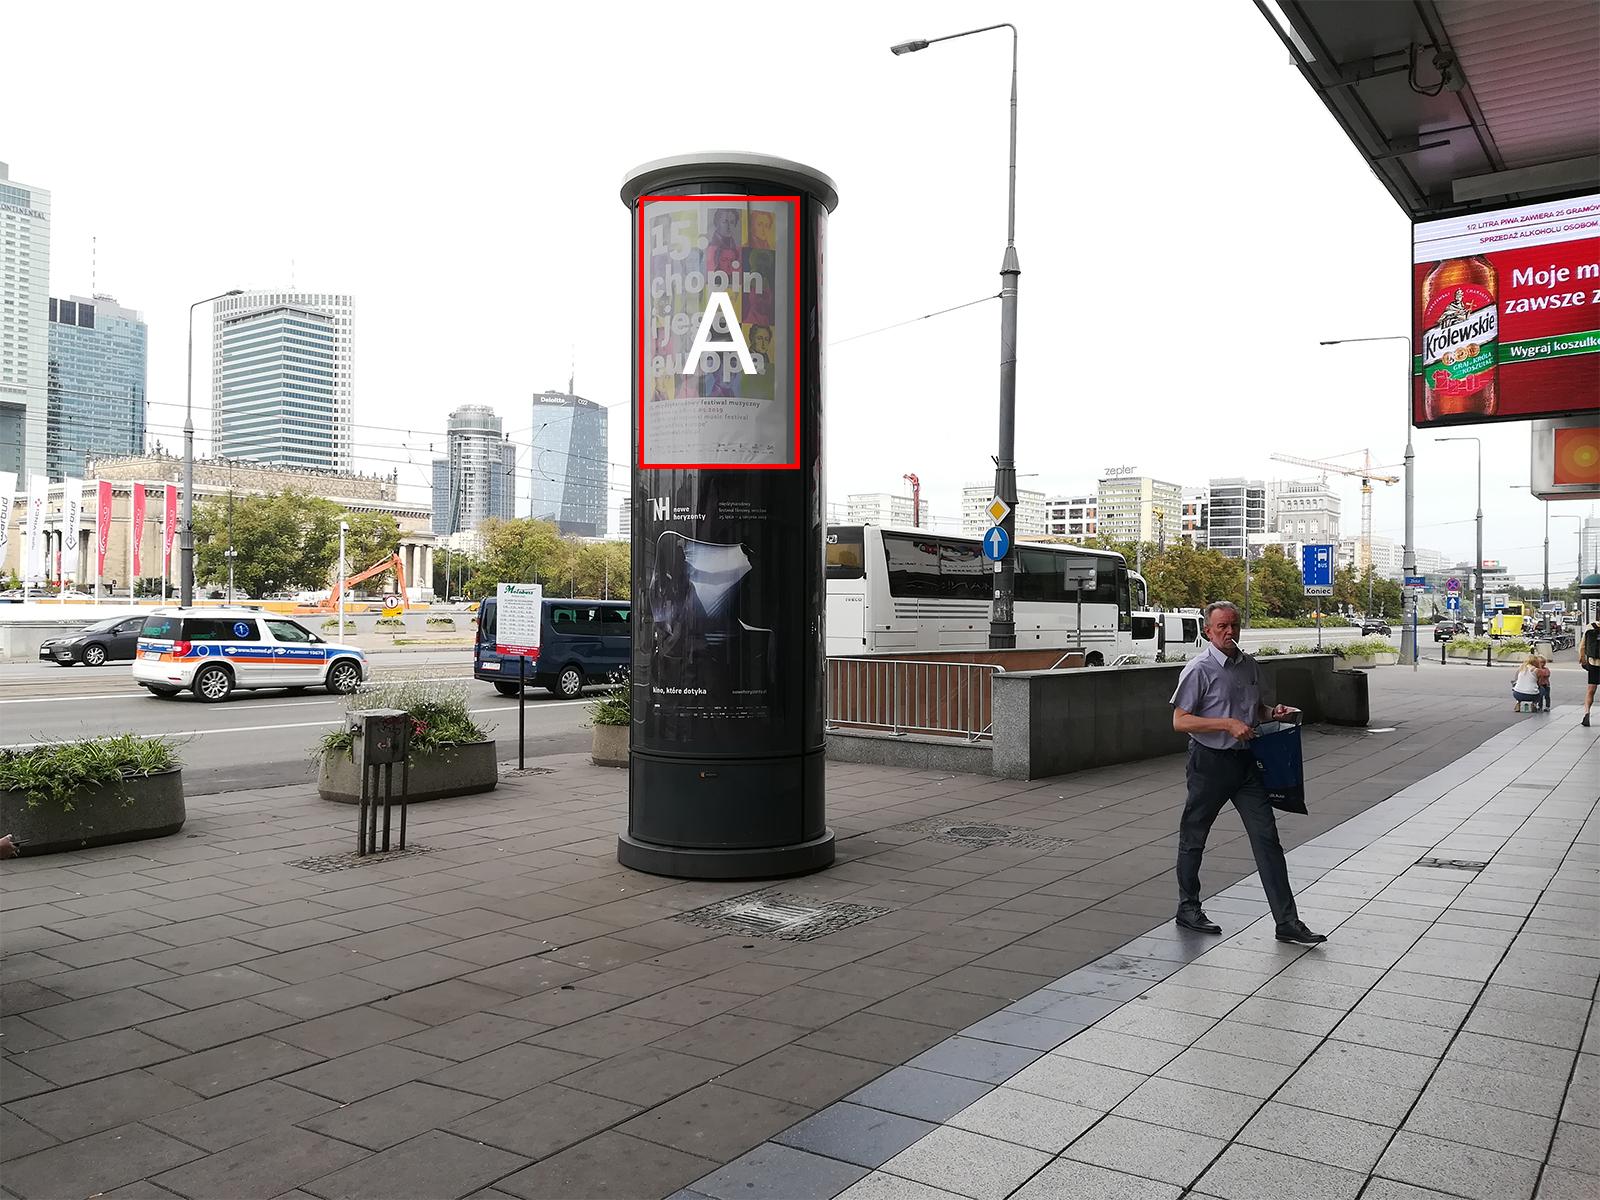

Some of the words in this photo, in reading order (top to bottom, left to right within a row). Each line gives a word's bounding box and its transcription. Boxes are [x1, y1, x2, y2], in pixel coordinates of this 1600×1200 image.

[1478, 220, 1499, 229] LITRA
[1500, 217, 1519, 225] PIWA
[1520, 212, 1554, 222] ZAWIERA
[1519, 226, 1561, 238] ALKOHOLU
[1563, 220, 1598, 231] OSOBOM
[651, 261, 763, 300] chopin
[1512, 264, 1570, 288] Moje
[1504, 290, 1586, 315] zawsze
[1426, 313, 1495, 360] Królewskie
[1510, 342, 1551, 358] Wygraj
[729, 399, 760, 408] muzyczny
[673, 513, 706, 521] horyzonty
[1306, 587, 1331, 595] Koniec
[666, 686, 682, 695] które
[683, 687, 707, 696] dotyka
